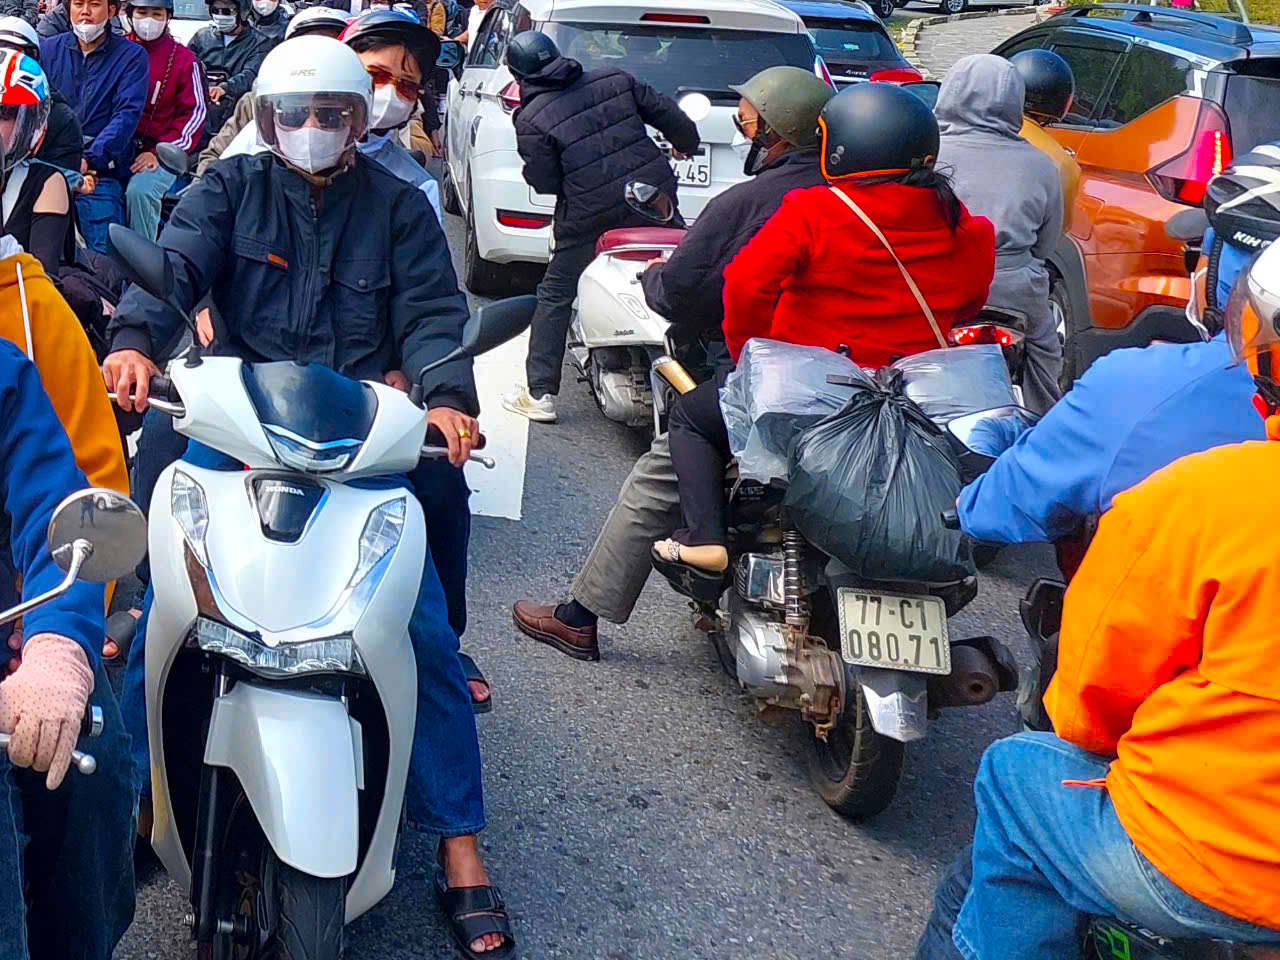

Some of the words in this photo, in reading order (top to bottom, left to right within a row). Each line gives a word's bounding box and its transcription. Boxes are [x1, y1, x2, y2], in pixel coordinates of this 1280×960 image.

[265, 486, 305, 496] HONDA
[854, 594, 927, 631] 77-C1
[848, 628, 942, 668] 080.71
